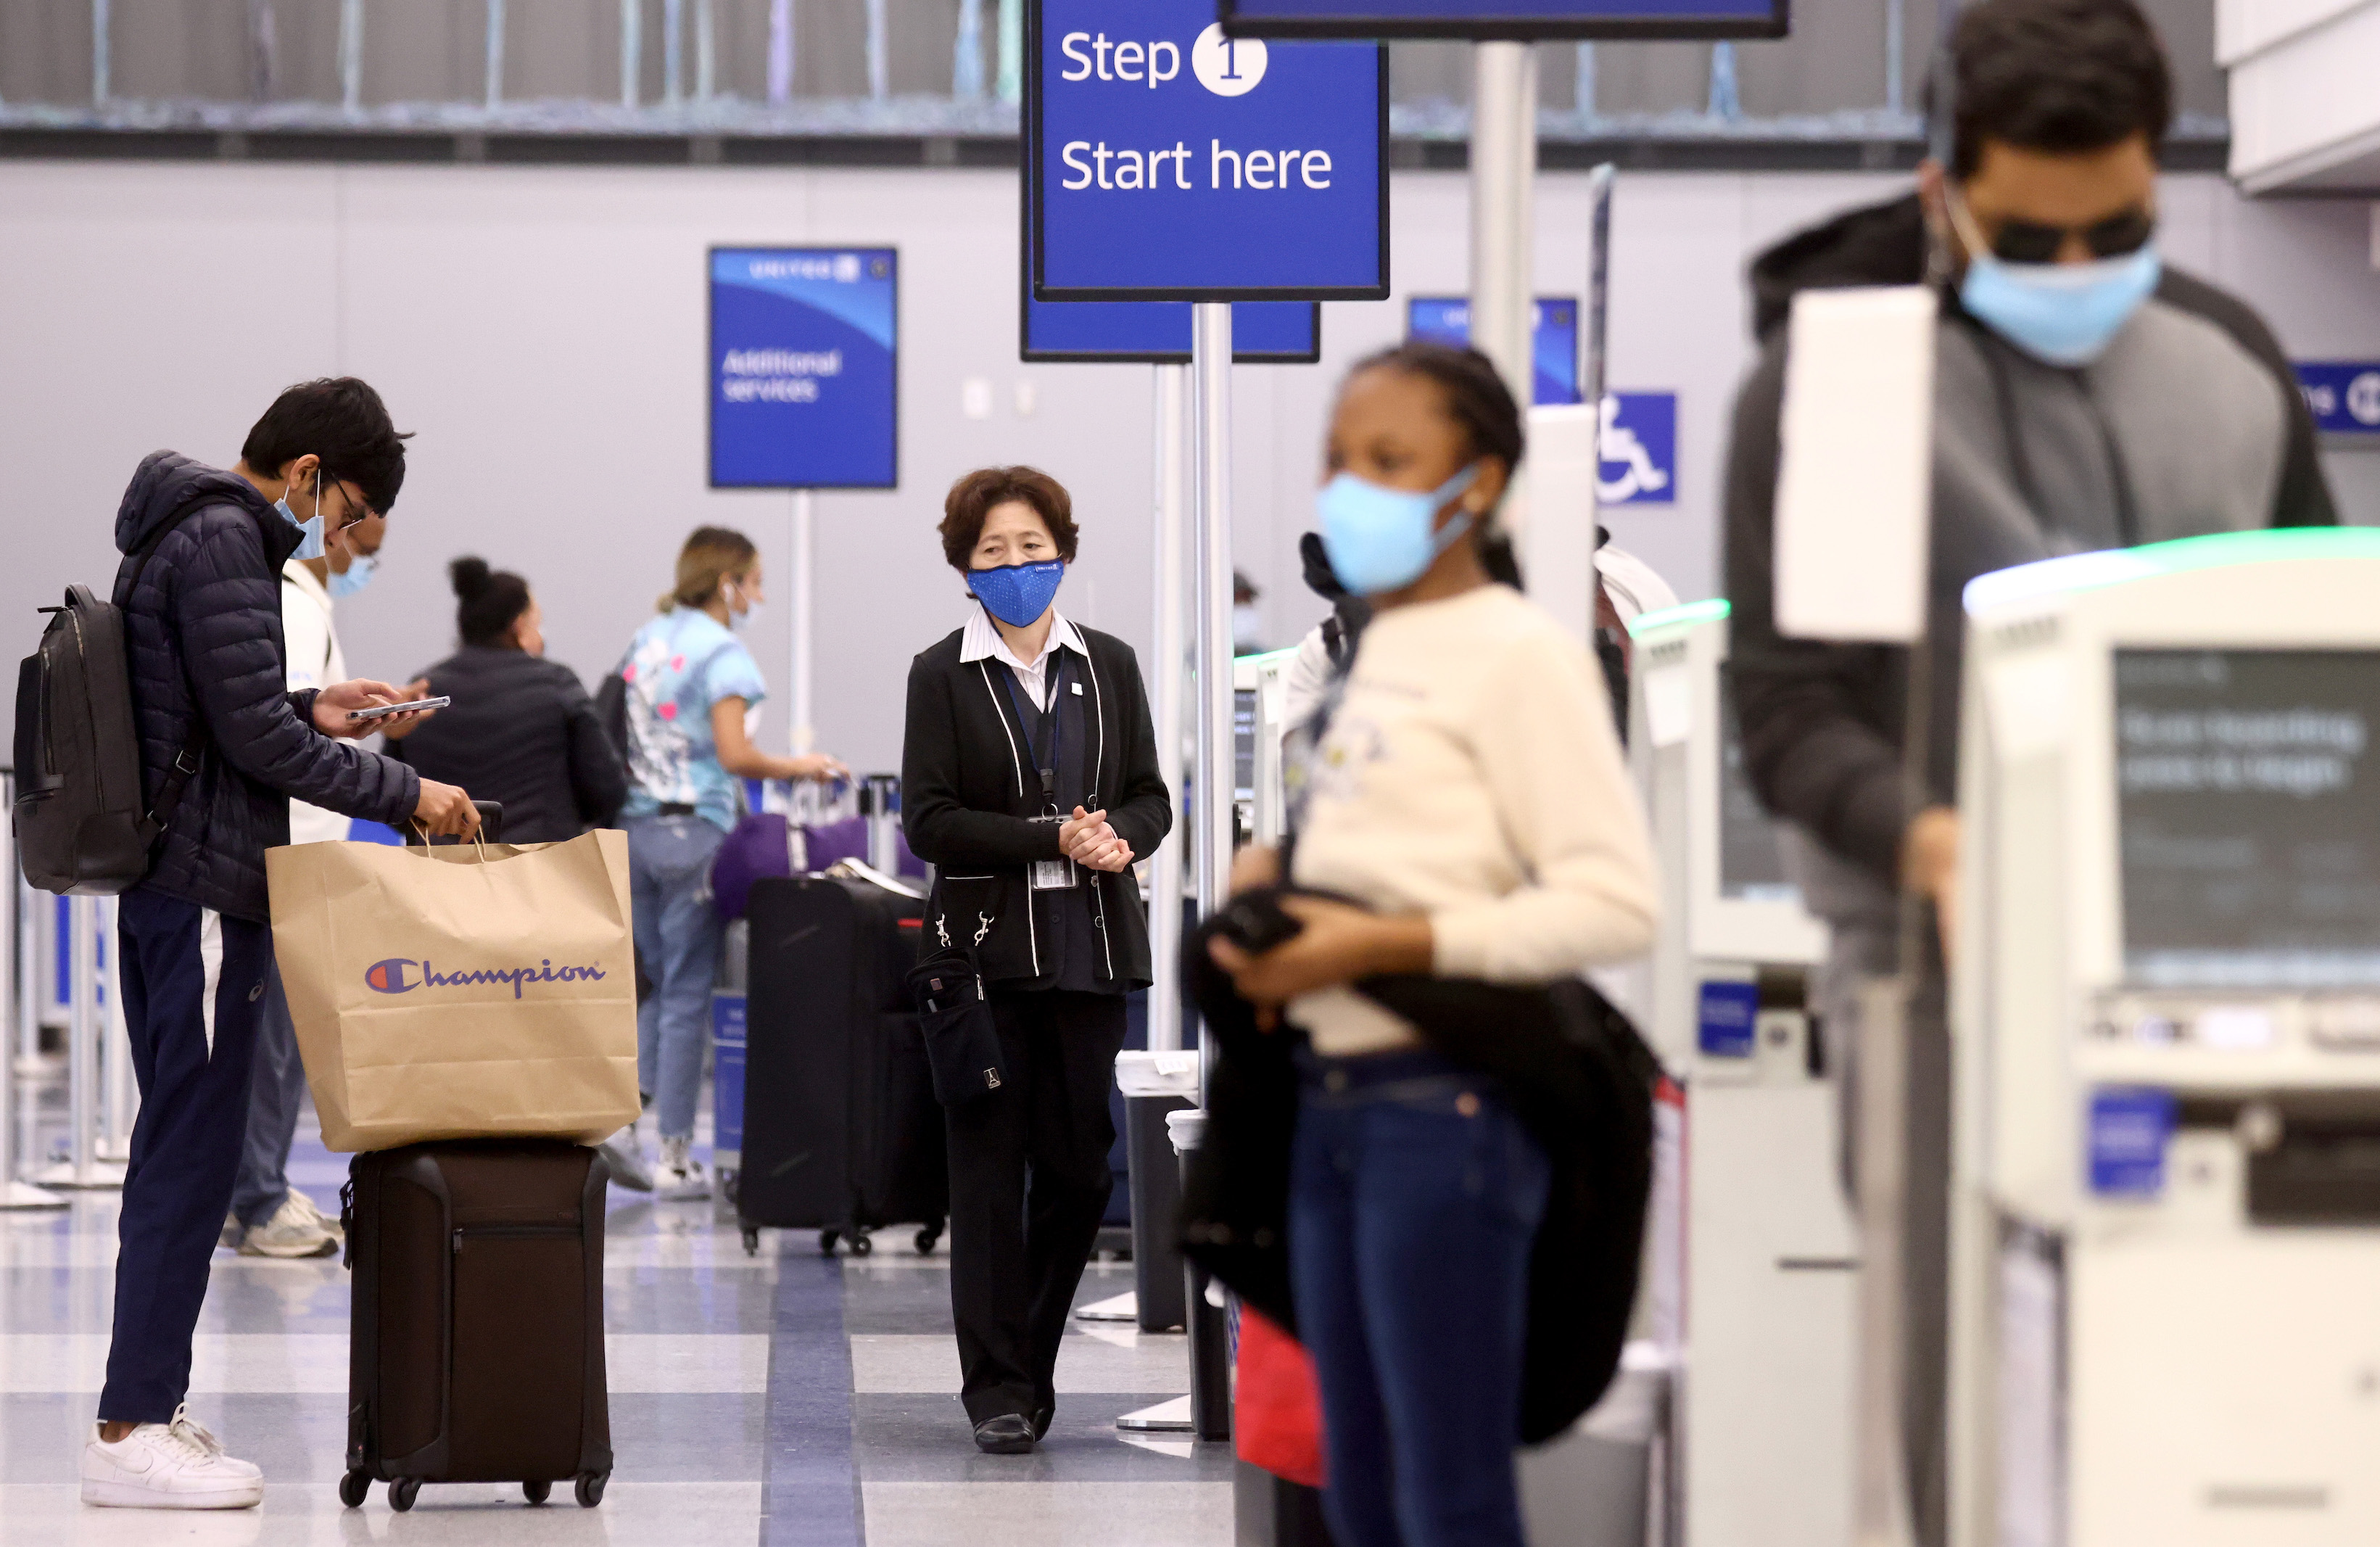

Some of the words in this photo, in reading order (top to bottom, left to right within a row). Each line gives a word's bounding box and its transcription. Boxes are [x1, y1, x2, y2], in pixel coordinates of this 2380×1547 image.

[1061, 31, 1181, 88] Step
[1218, 37, 1243, 81] 1
[1061, 140, 1193, 190] Start
[1211, 139, 1333, 190] here
[724, 349, 841, 376] Additional
[724, 378, 819, 401] services
[365, 958, 606, 999] Champion
